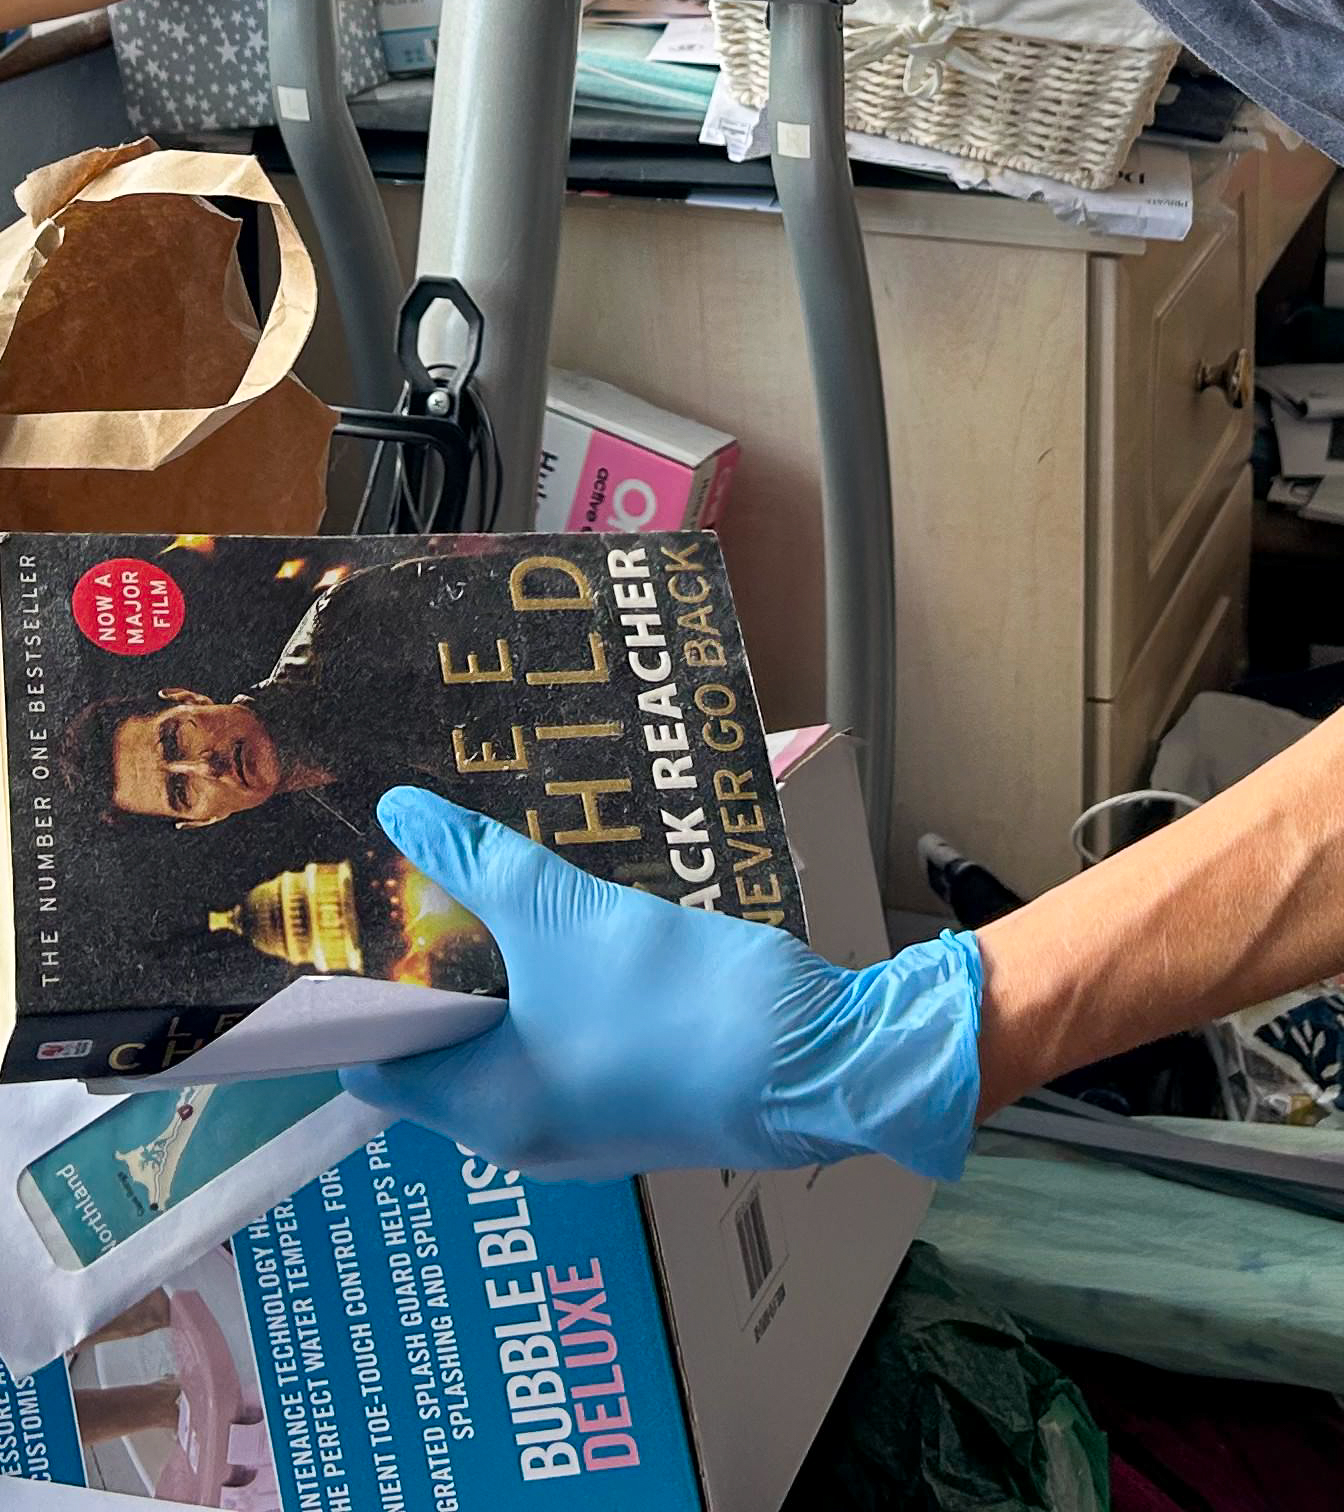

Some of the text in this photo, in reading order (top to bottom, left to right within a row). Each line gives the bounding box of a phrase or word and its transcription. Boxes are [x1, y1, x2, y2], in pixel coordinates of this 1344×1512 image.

[94, 573, 117, 641] NOW A
[122, 570, 145, 645] MAJOR
[150, 579, 171, 629] FILM
[660, 542, 728, 668] BACK
[509, 555, 643, 848] HILD
[607, 547, 698, 790] REACHER
[693, 682, 745, 753] GO
[19, 554, 60, 988] THE NUMBER ONE BESTSELLER
[660, 806, 723, 913] ACK
[319, 1167, 347, 1212] FOR
[373, 1175, 407, 1247] HELPS
[273, 1198, 310, 1294] TEMPER
[329, 1216, 368, 1317] CONTROL
[389, 1252, 423, 1327] GUARD
[252, 1246, 299, 1388] TECHNOLOGY
[293, 1297, 326, 1373] WATER
[404, 1182, 475, 1441] SPLASHING AND SPILLS
[455, 1141, 581, 1481] BUBBLE BLIS
[349, 1322, 393, 1448] TOE-TOUCH
[404, 1332, 442, 1420] SPLASH
[546, 1257, 641, 1473] DELUXE
[307, 1378, 346, 1478] PERFECT
